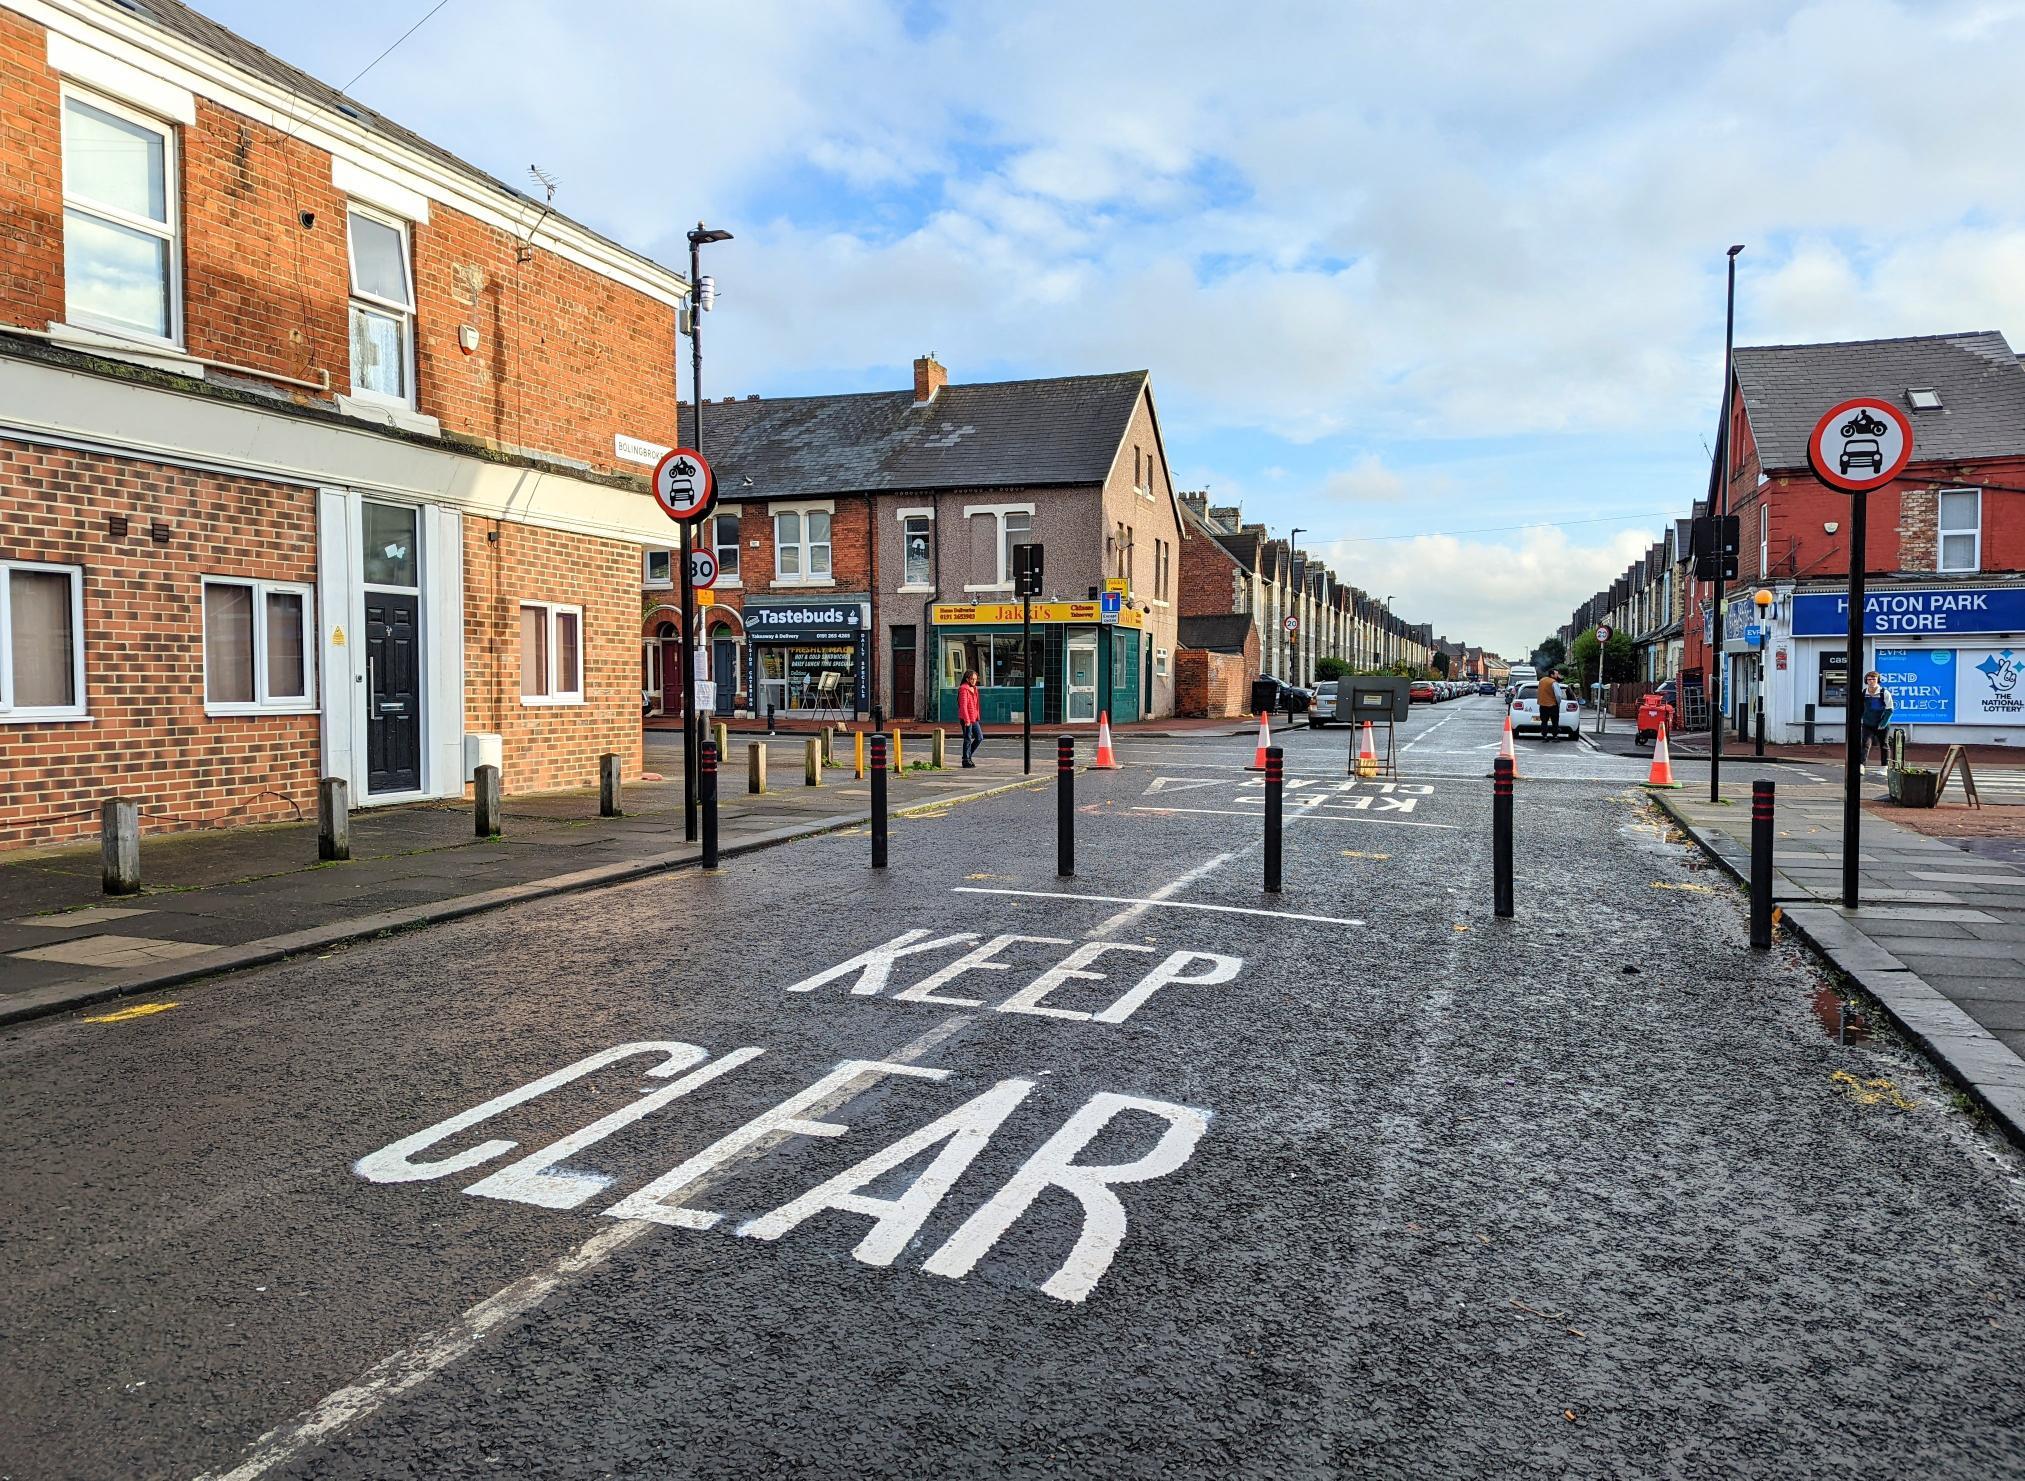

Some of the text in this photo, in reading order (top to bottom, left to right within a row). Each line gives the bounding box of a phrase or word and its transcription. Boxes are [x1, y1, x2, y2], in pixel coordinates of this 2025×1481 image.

[1838, 594, 1988, 613] HATON PARK
[759, 608, 844, 624] Tastebuds
[1875, 613, 1947, 631] STORE
[1880, 672, 1918, 683] SEND
[1882, 686, 1941, 697] ETURN
[1892, 699, 1949, 710] OLLECT
[788, 928, 1243, 1024] KEEP
[354, 1039, 1215, 1305] CLEAR
